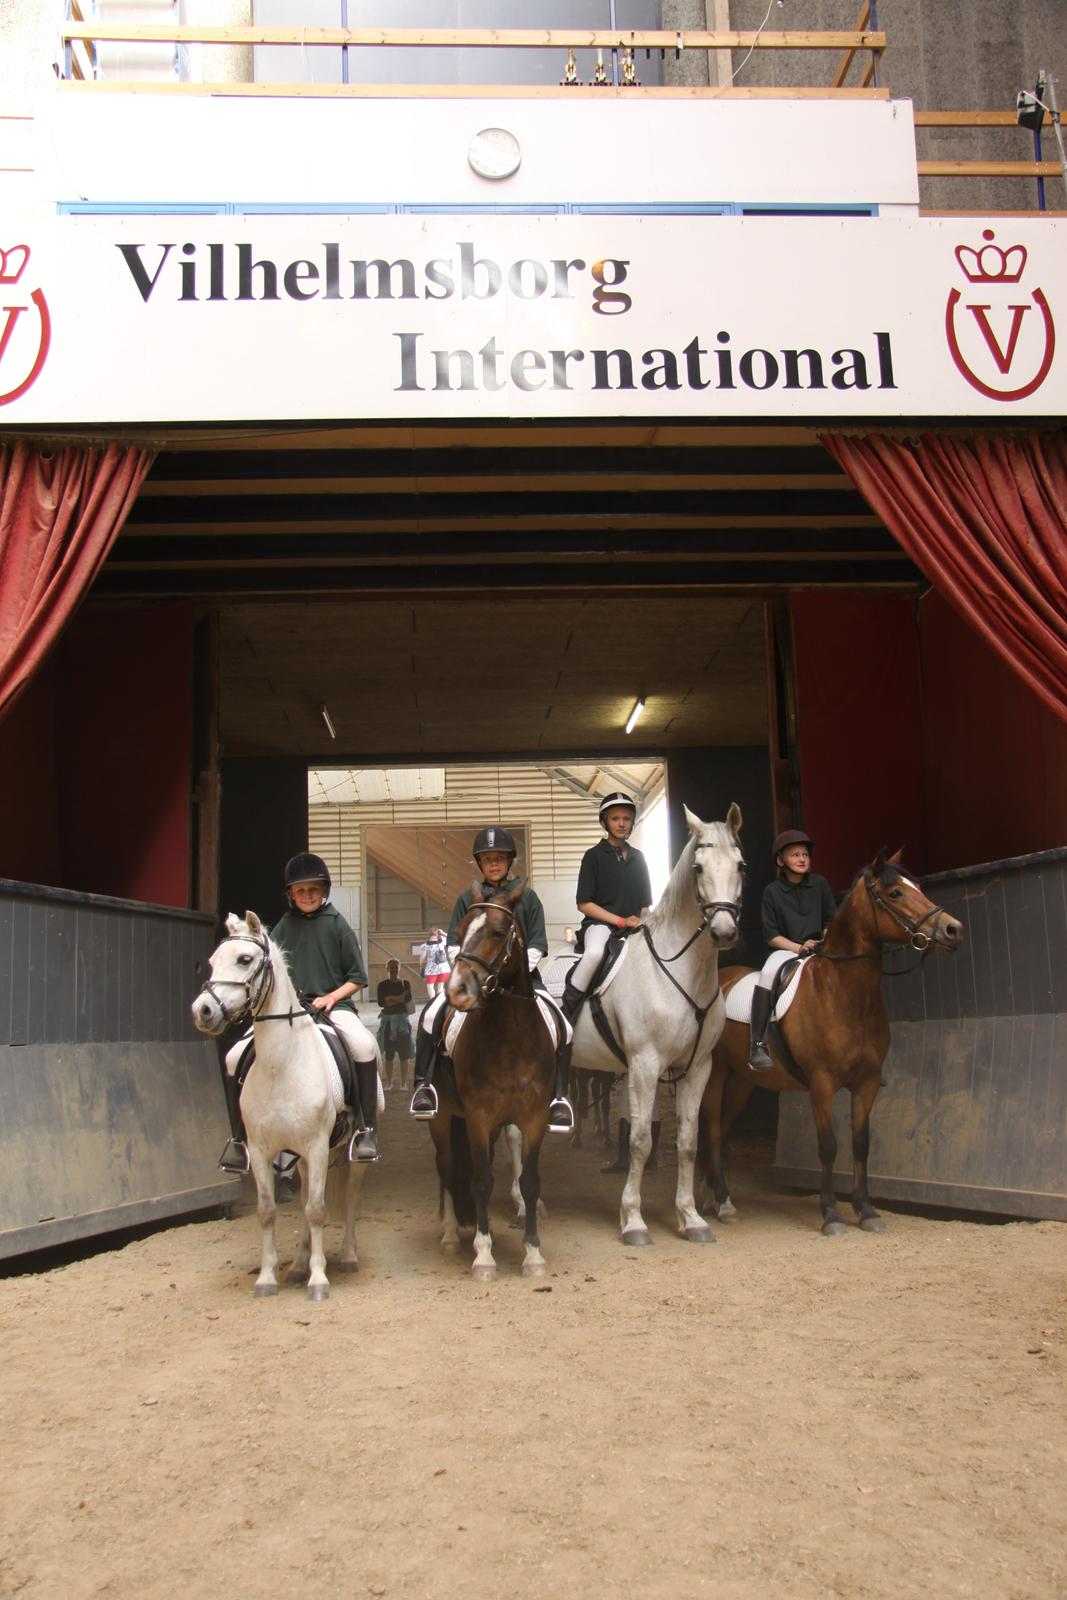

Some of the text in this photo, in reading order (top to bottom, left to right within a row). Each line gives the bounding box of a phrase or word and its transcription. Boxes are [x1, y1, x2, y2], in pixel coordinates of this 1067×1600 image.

[115, 242, 632, 316] Vilhelmsborg
[393, 331, 899, 391] International
[965, 304, 1032, 375] V
